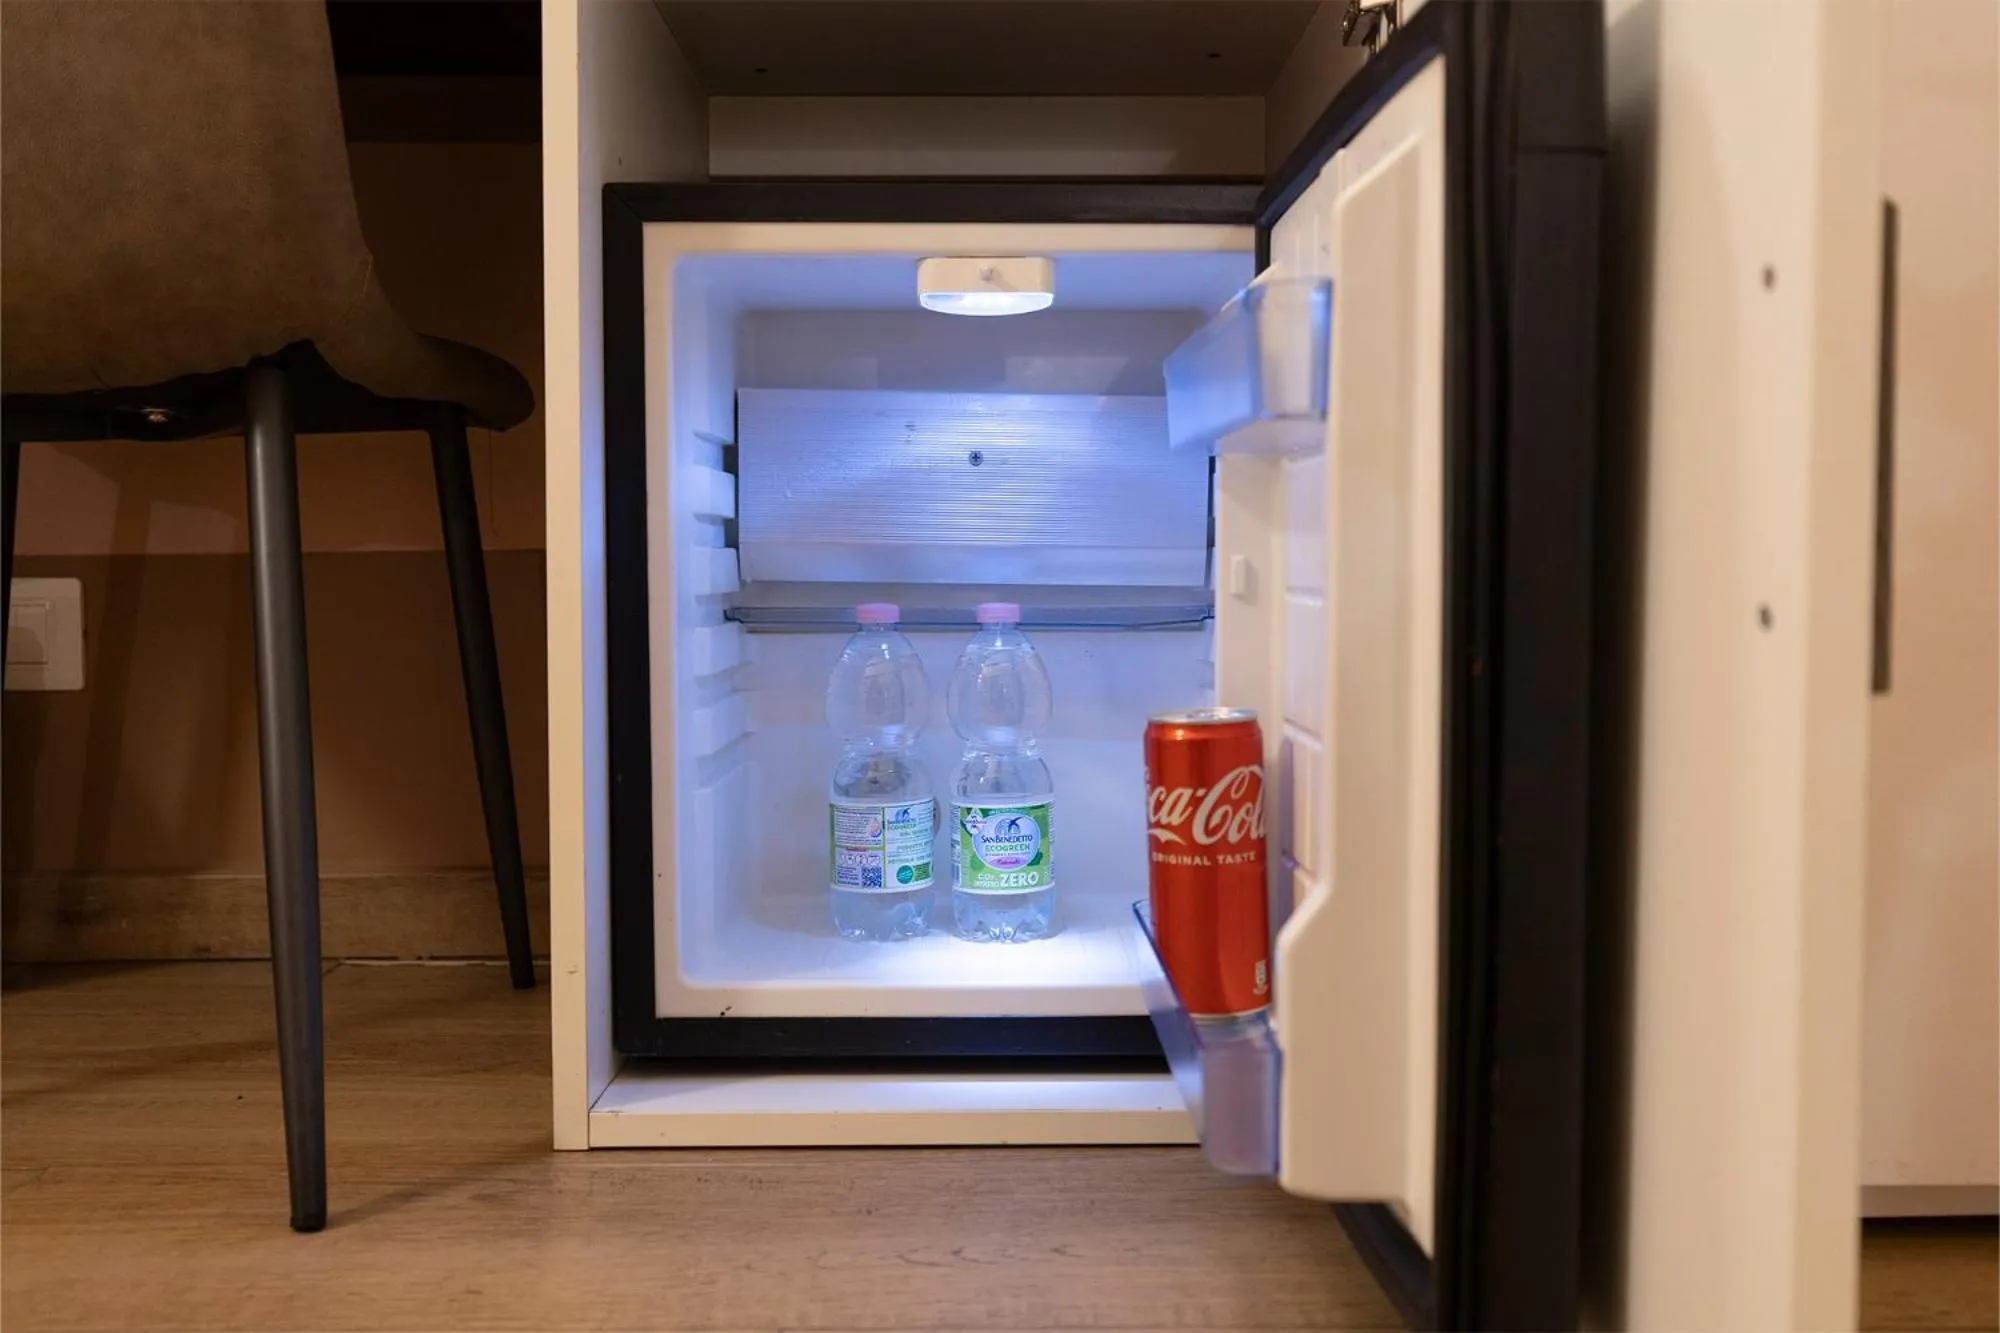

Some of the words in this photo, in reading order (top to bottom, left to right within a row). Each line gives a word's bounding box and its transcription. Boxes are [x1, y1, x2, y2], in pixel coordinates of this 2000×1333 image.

[985, 843, 1030, 852] ECOGREEN
[1151, 851, 1212, 866] ORIGINAL
[1216, 850, 1256, 865] TASTE
[999, 871, 1039, 887] ZERO
